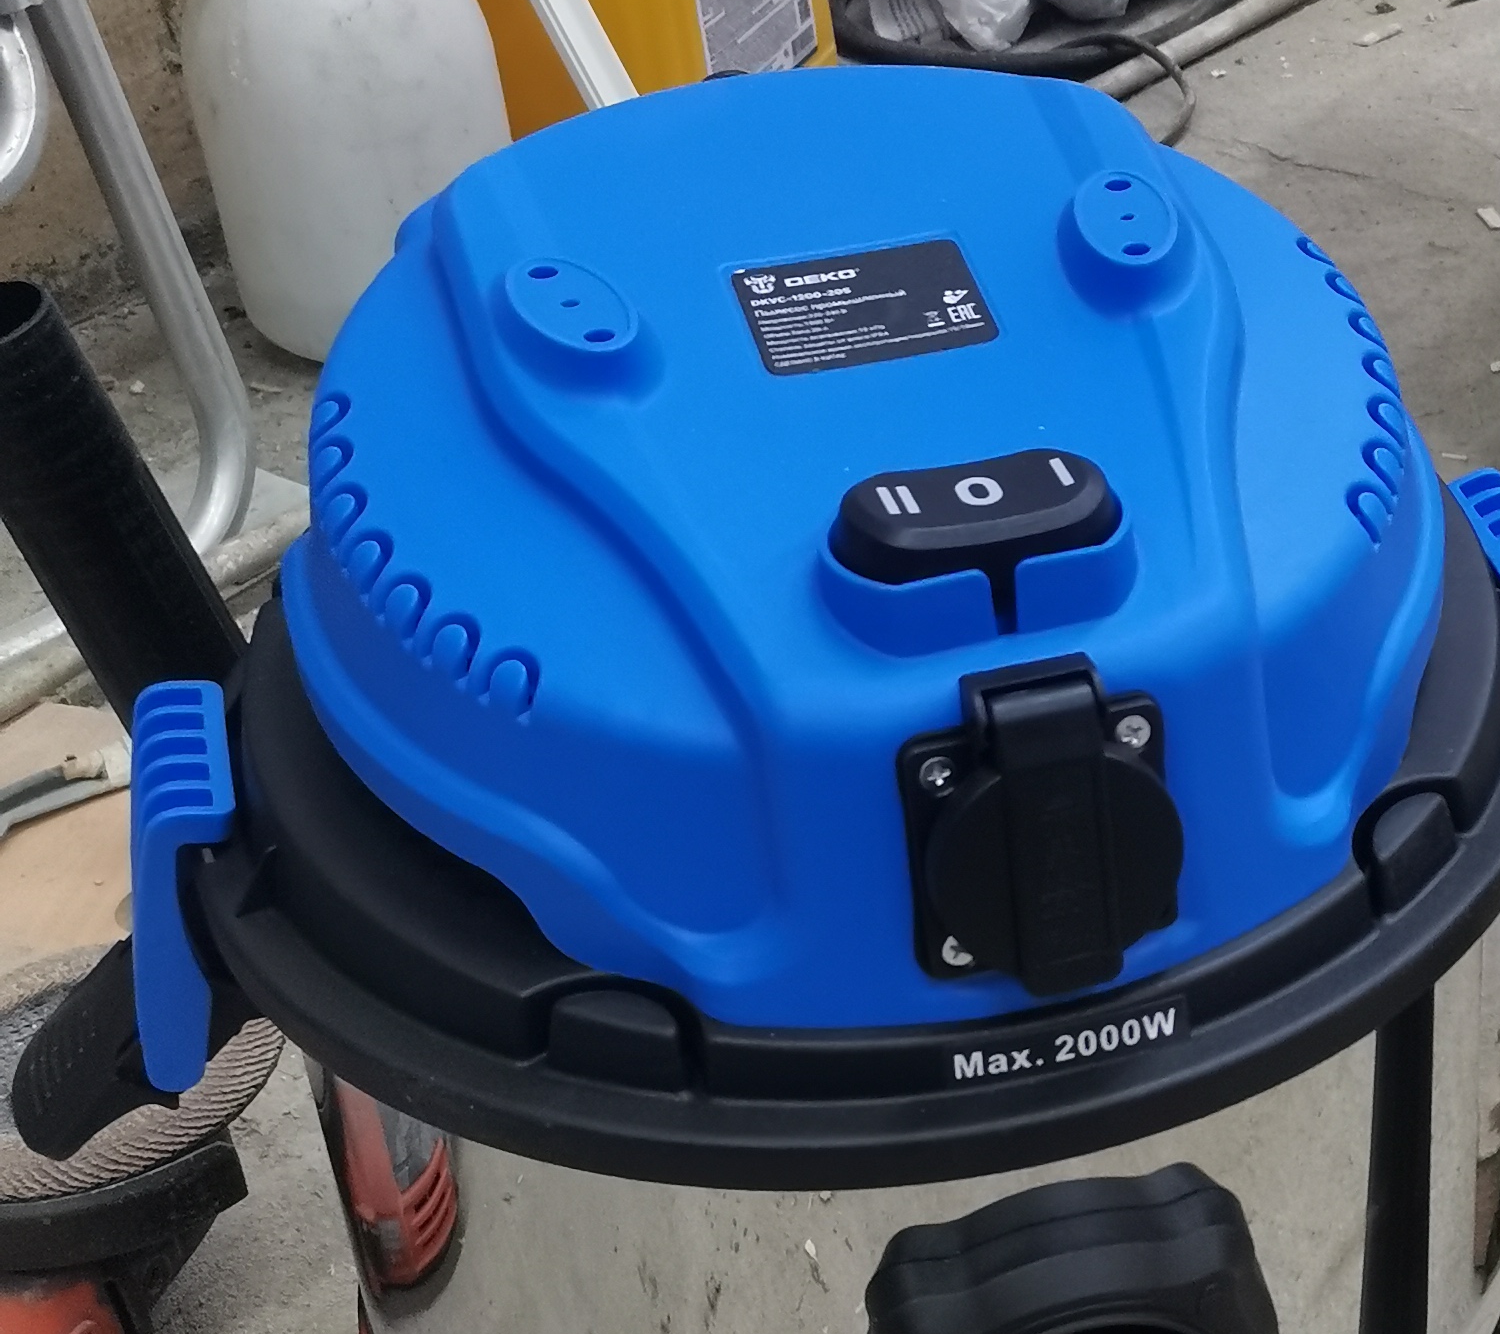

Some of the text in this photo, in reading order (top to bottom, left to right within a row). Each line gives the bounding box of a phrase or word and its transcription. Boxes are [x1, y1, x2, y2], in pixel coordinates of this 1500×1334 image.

[783, 268, 858, 287] DEKO
[953, 1006, 1178, 1081] Max. 2000W
